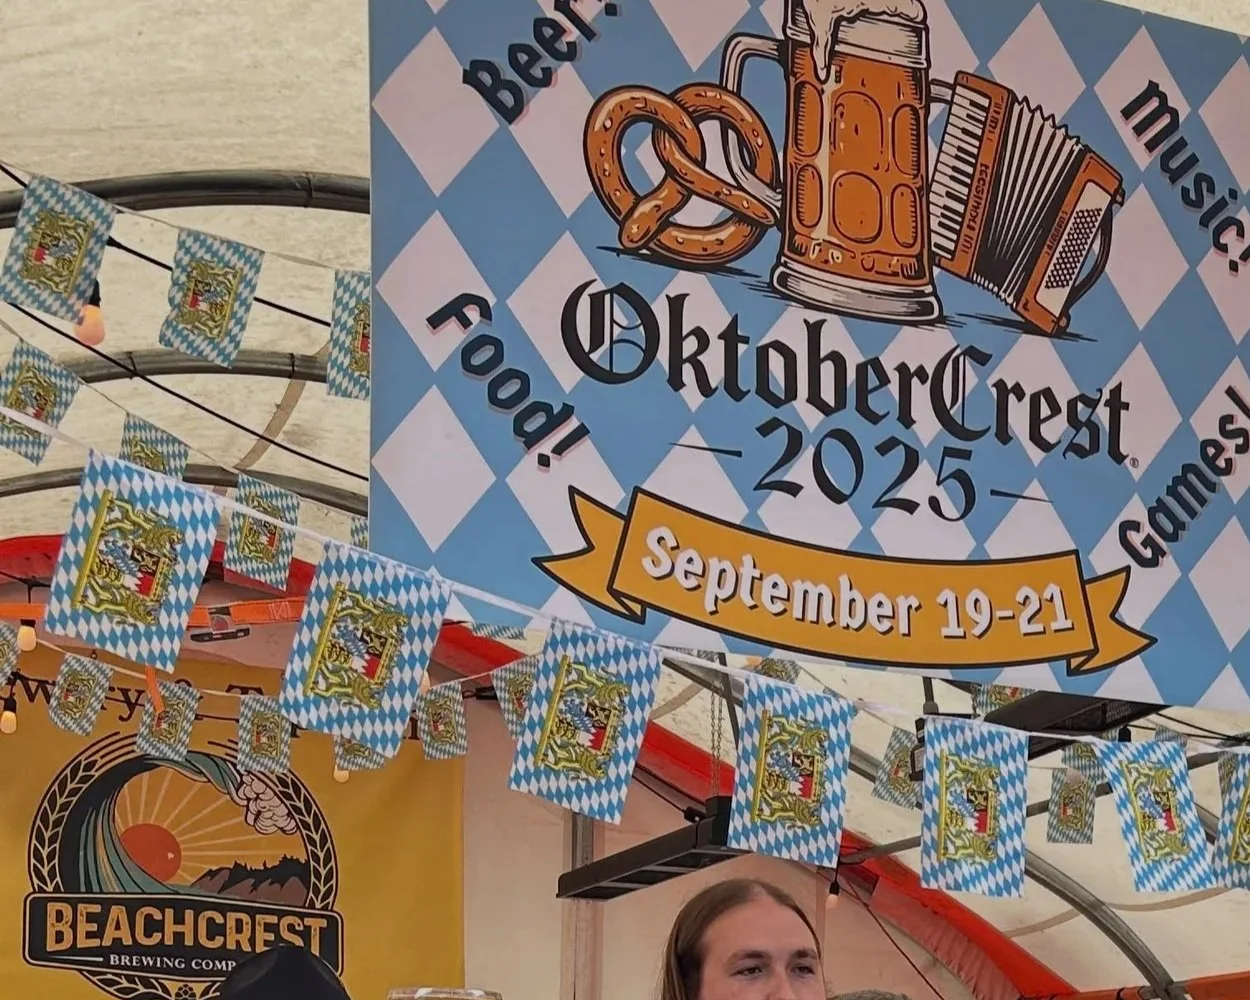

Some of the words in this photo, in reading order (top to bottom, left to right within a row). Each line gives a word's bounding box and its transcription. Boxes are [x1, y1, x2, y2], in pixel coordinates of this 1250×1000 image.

[462, 0, 618, 125] Beer
[425, 292, 591, 469] Food!
[755, 416, 977, 522] 2025
[641, 526, 922, 638] September
[936, 583, 1076, 641] 19-21
[46, 902, 328, 956] BEACHCREST
[109, 953, 186, 970] BREWING
[191, 957, 237, 972] COMP
